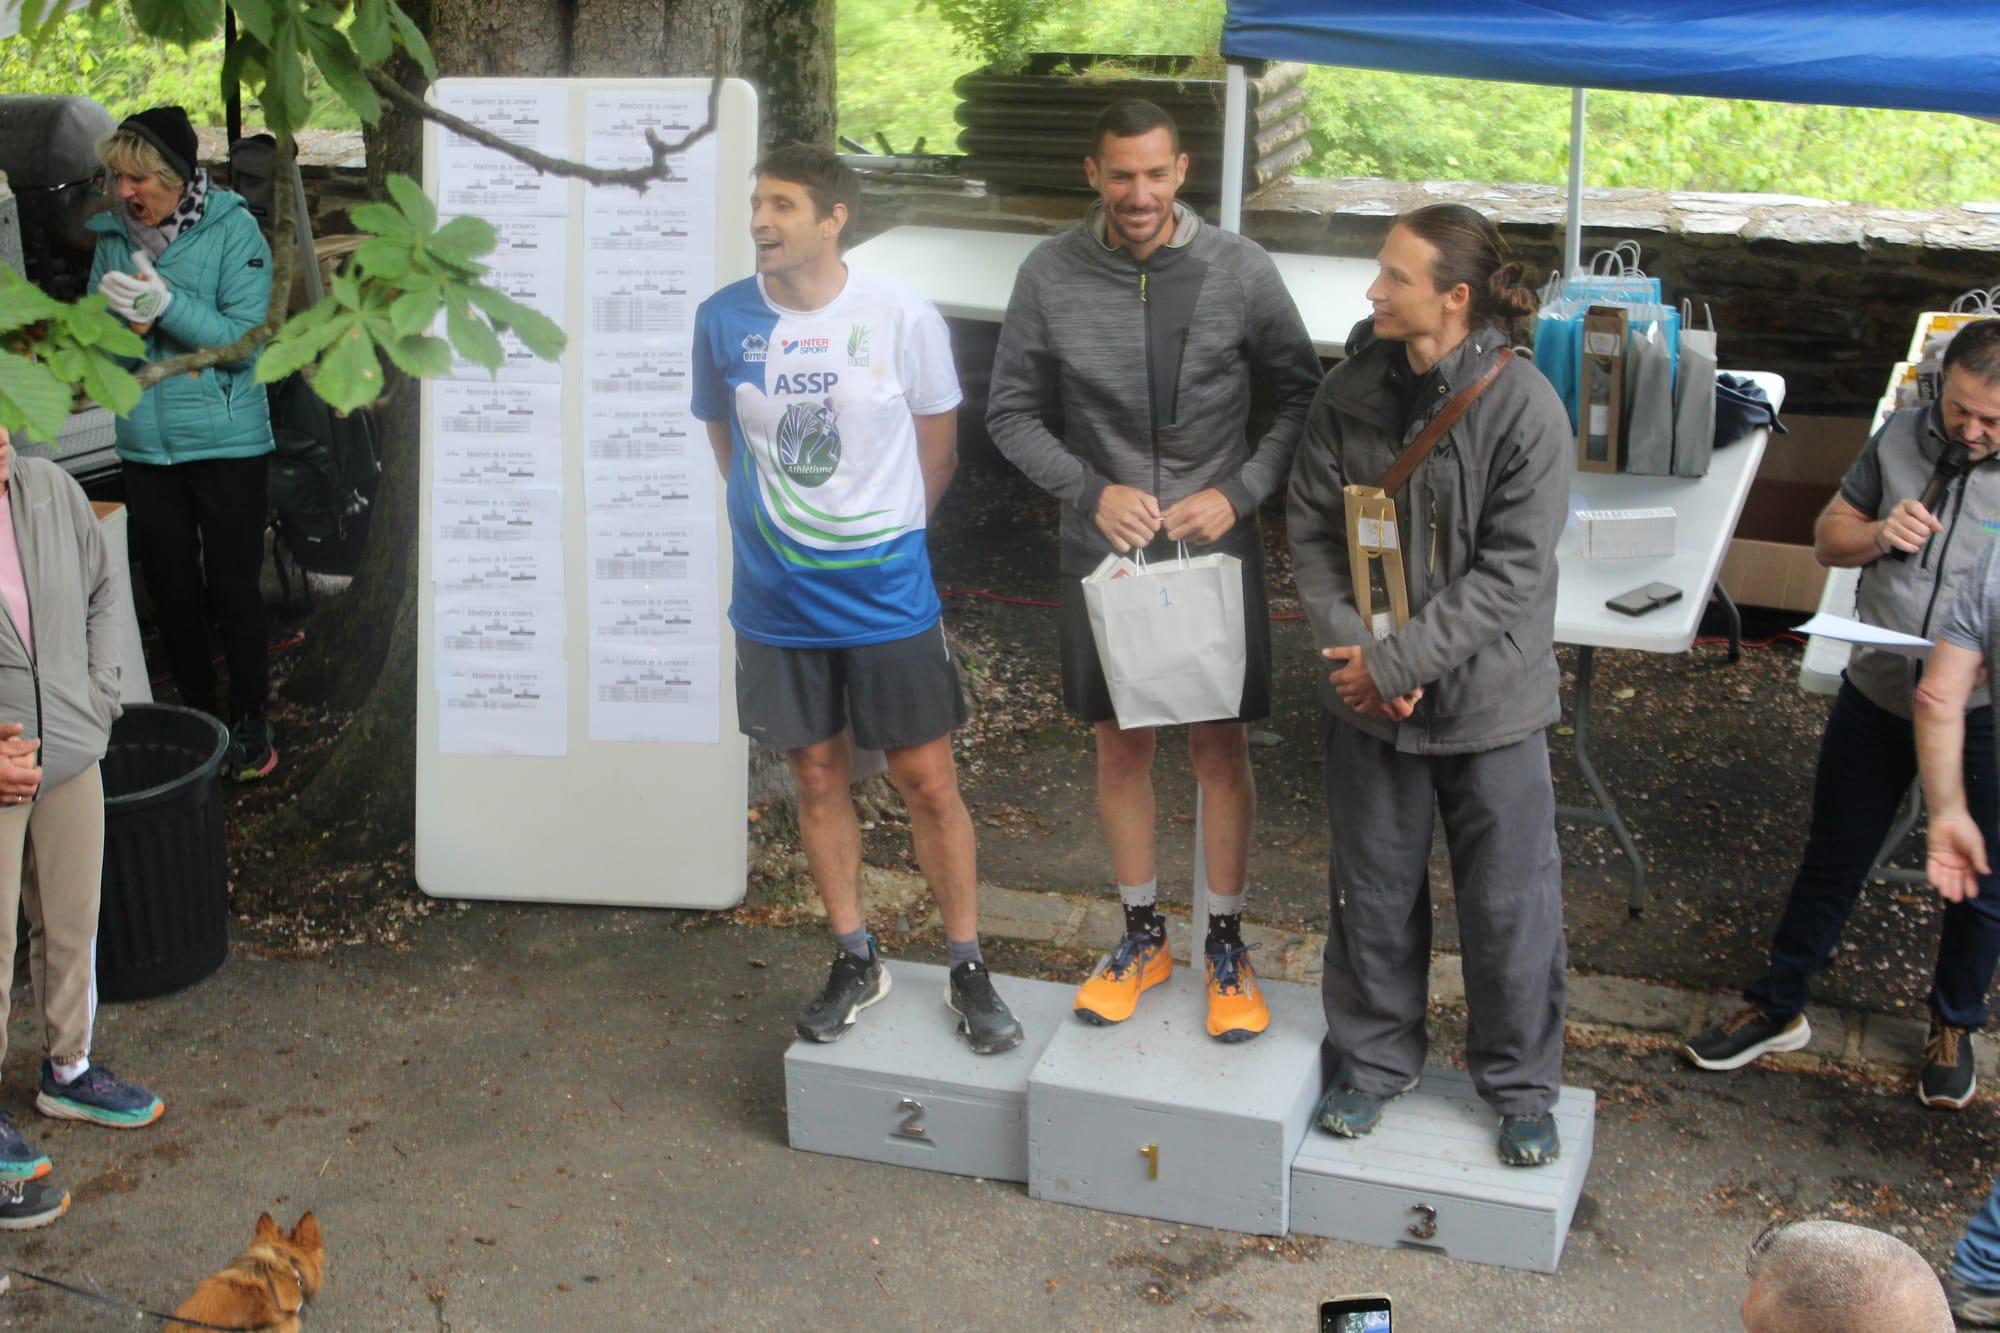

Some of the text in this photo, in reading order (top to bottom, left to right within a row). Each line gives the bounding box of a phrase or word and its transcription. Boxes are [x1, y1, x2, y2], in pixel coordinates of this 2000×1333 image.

[800, 338, 829, 347] INTER
[800, 346, 829, 355] SPORT
[773, 372, 839, 396] ASSP
[787, 464, 833, 474] Athlétisme
[1159, 586, 1176, 608] 1
[896, 1097, 926, 1135] 2
[1138, 1143, 1159, 1181] 1
[1406, 1203, 1437, 1239] 3
